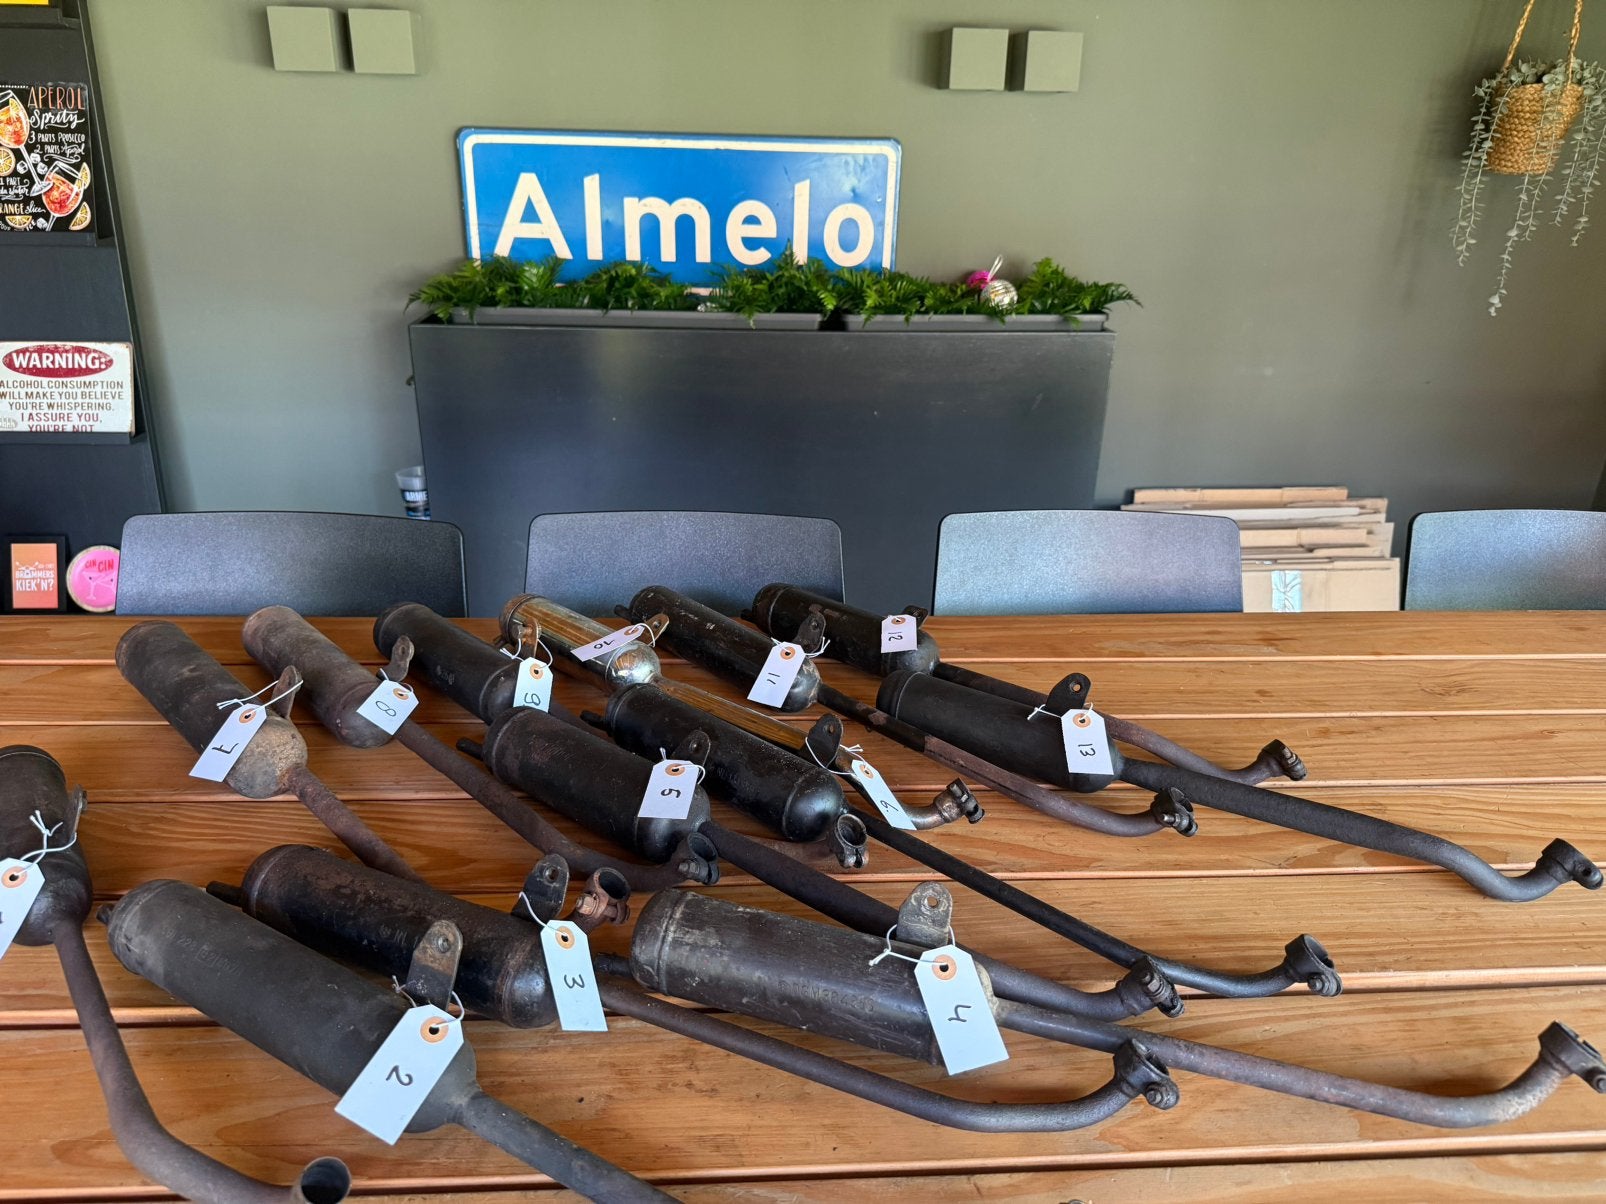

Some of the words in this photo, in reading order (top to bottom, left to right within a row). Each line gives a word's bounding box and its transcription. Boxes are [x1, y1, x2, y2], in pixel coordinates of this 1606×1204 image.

[28, 86, 85, 110] APEROL
[28, 131, 36, 144] 3
[37, 133, 56, 143] PARTS
[58, 132, 86, 143] PROSECCO
[34, 145, 43, 154] 2
[44, 145, 60, 154] PARTS
[6, 177, 21, 186] PART
[25, 200, 46, 215] slice
[493, 172, 875, 268] Almelo
[12, 352, 107, 369] WARNING:
[0, 380, 46, 389] ALCOHOL
[47, 380, 124, 389] CONSUMPTION
[0, 391, 24, 400] WILL
[25, 391, 55, 400] MAKE
[58, 391, 78, 400] YOU
[81, 391, 124, 400] BELIEVE
[8, 401, 45, 411] YOU'RE
[46, 401, 115, 411] WHISPERING.
[21, 413, 24, 422] I
[28, 412, 73, 422] ASSURE
[77, 412, 102, 423] YOU,
[72, 424, 95, 432] NOT
[97, 559, 114, 572] CIN
[16, 579, 54, 591] KIEK'N?
[888, 631, 903, 642] 12
[375, 700, 397, 717] 8
[211, 742, 240, 755] 7
[1077, 743, 1096, 757] 13
[660, 788, 681, 799] 5
[563, 973, 586, 990] 3
[947, 1003, 972, 1024] 4
[386, 1065, 414, 1087] 2
